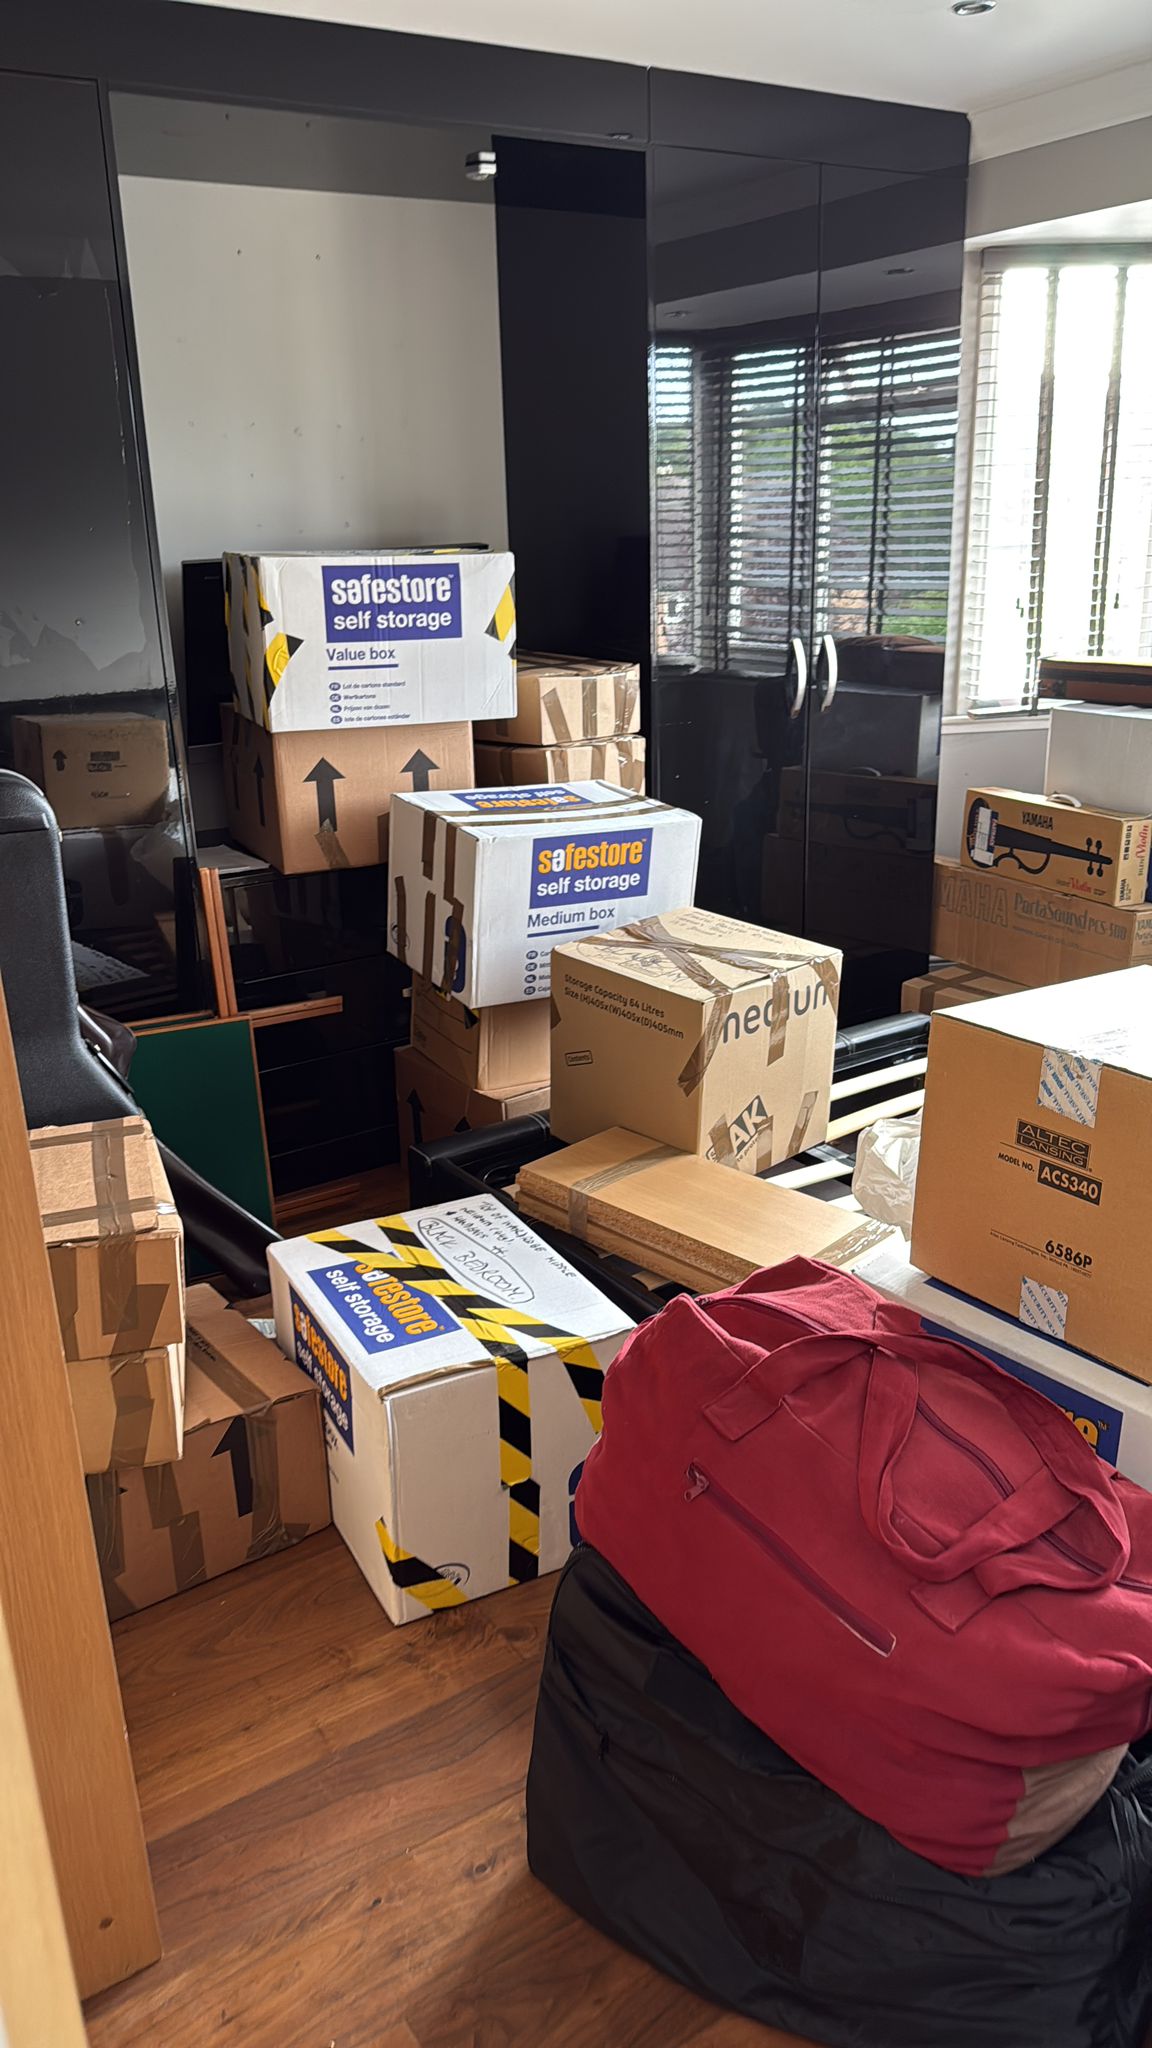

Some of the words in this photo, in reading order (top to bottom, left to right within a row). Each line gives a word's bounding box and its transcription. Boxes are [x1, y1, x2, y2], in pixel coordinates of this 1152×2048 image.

[331, 573, 452, 605] safestore
[333, 611, 371, 630] self
[376, 610, 451, 631] storage
[326, 648, 365, 661] Value
[370, 647, 396, 660] box
[1022, 811, 1054, 831] YAMAHA
[1136, 825, 1150, 859] Violin
[538, 841, 643, 874] safestore
[537, 877, 571, 896] self
[574, 873, 640, 891] storage
[1119, 878, 1127, 902] YAMAHA
[527, 911, 585, 928] Medium
[590, 907, 616, 920] box
[564, 987, 579, 1000] Size
[564, 974, 593, 992] Storage
[594, 985, 628, 1007] Capacity
[629, 998, 640, 1009] 64
[641, 1002, 665, 1018] Litres
[729, 1097, 769, 1155] AK
[1021, 1124, 1086, 1154] ALTEC
[998, 1152, 1021, 1167] MODEL
[1022, 1162, 1035, 1172] NO.
[1020, 1136, 1084, 1166] LANSING
[1040, 1166, 1098, 1199] ACS340
[422, 1220, 458, 1249] BLACK
[1045, 1240, 1093, 1268] 6586P
[326, 1268, 357, 1293] self
[343, 1293, 395, 1344] storage
[1026, 1286, 1048, 1320] SECURITY
[293, 1303, 348, 1402] safestore
[296, 1341, 313, 1373] self
[313, 1366, 349, 1432] storage
